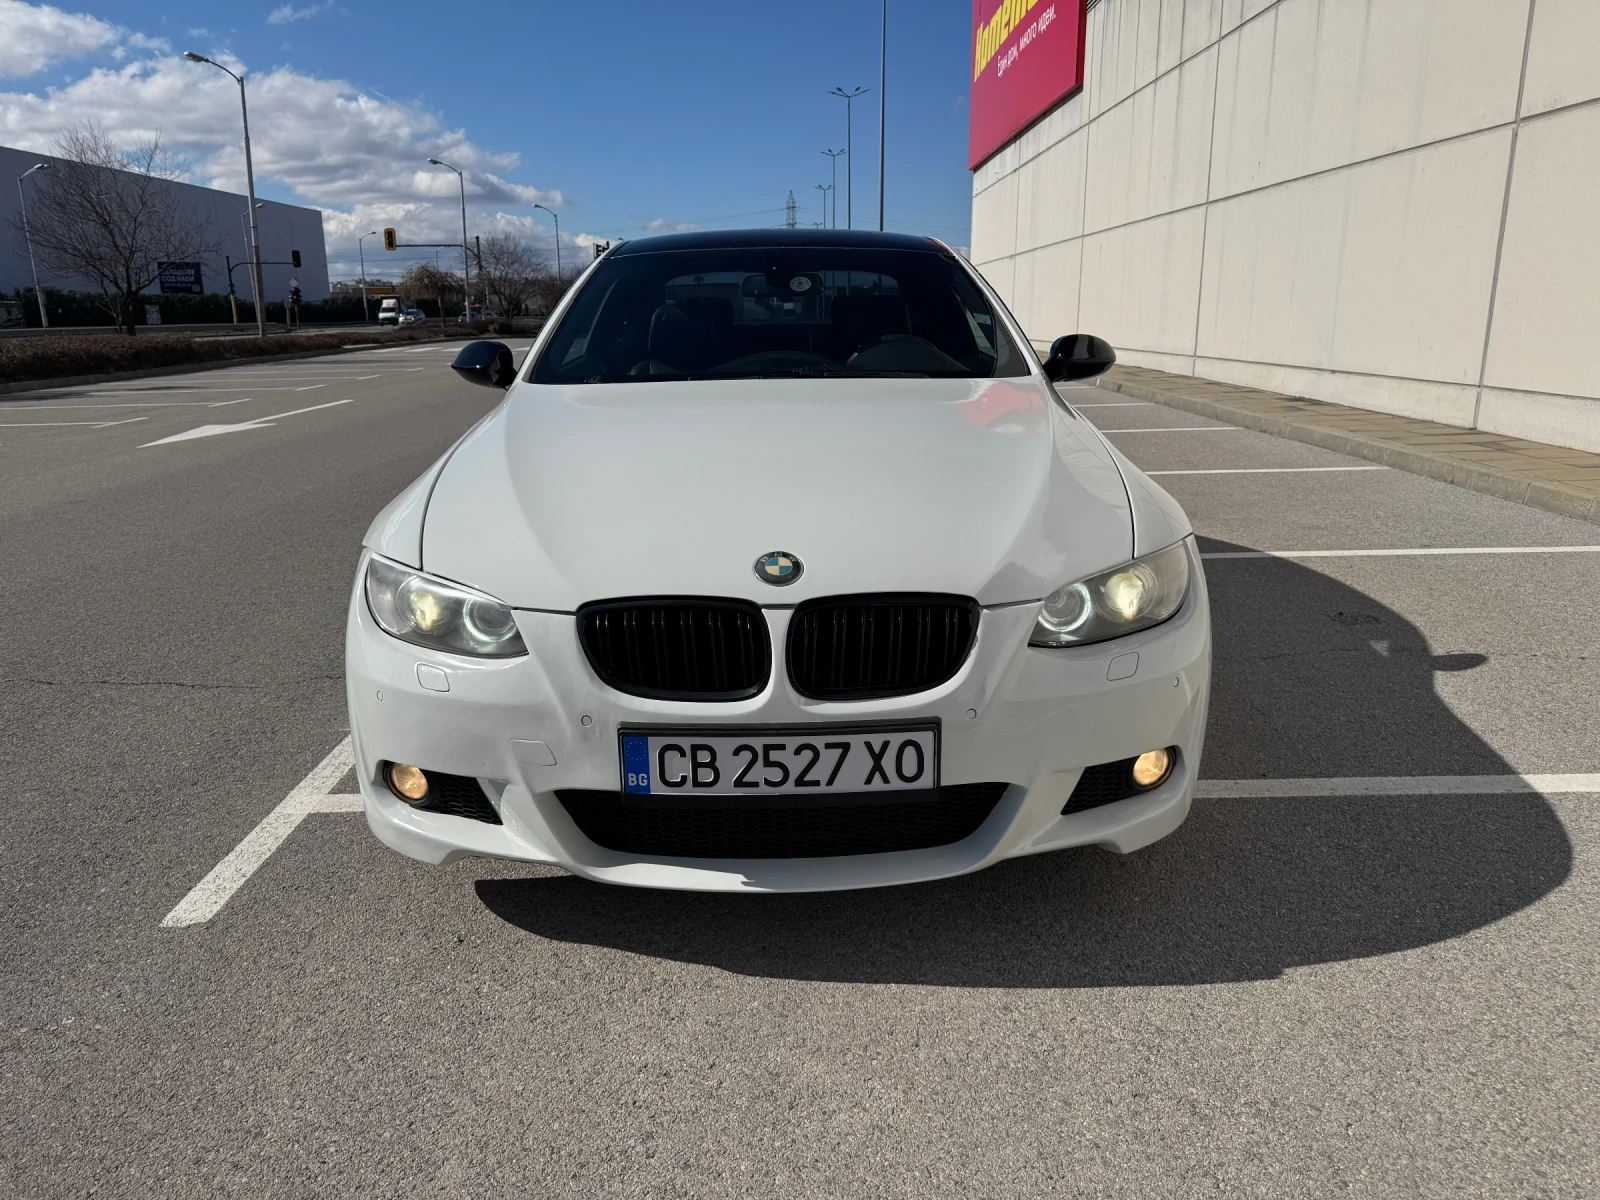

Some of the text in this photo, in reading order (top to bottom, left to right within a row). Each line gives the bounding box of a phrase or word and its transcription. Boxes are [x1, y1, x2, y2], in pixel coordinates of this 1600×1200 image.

[1019, 22, 1038, 53] много
[161, 268, 195, 276] КЛАДОВЕ
[760, 552, 798, 562] BMW
[657, 739, 925, 788] CB 2527 XO
[628, 773, 648, 787] BG
